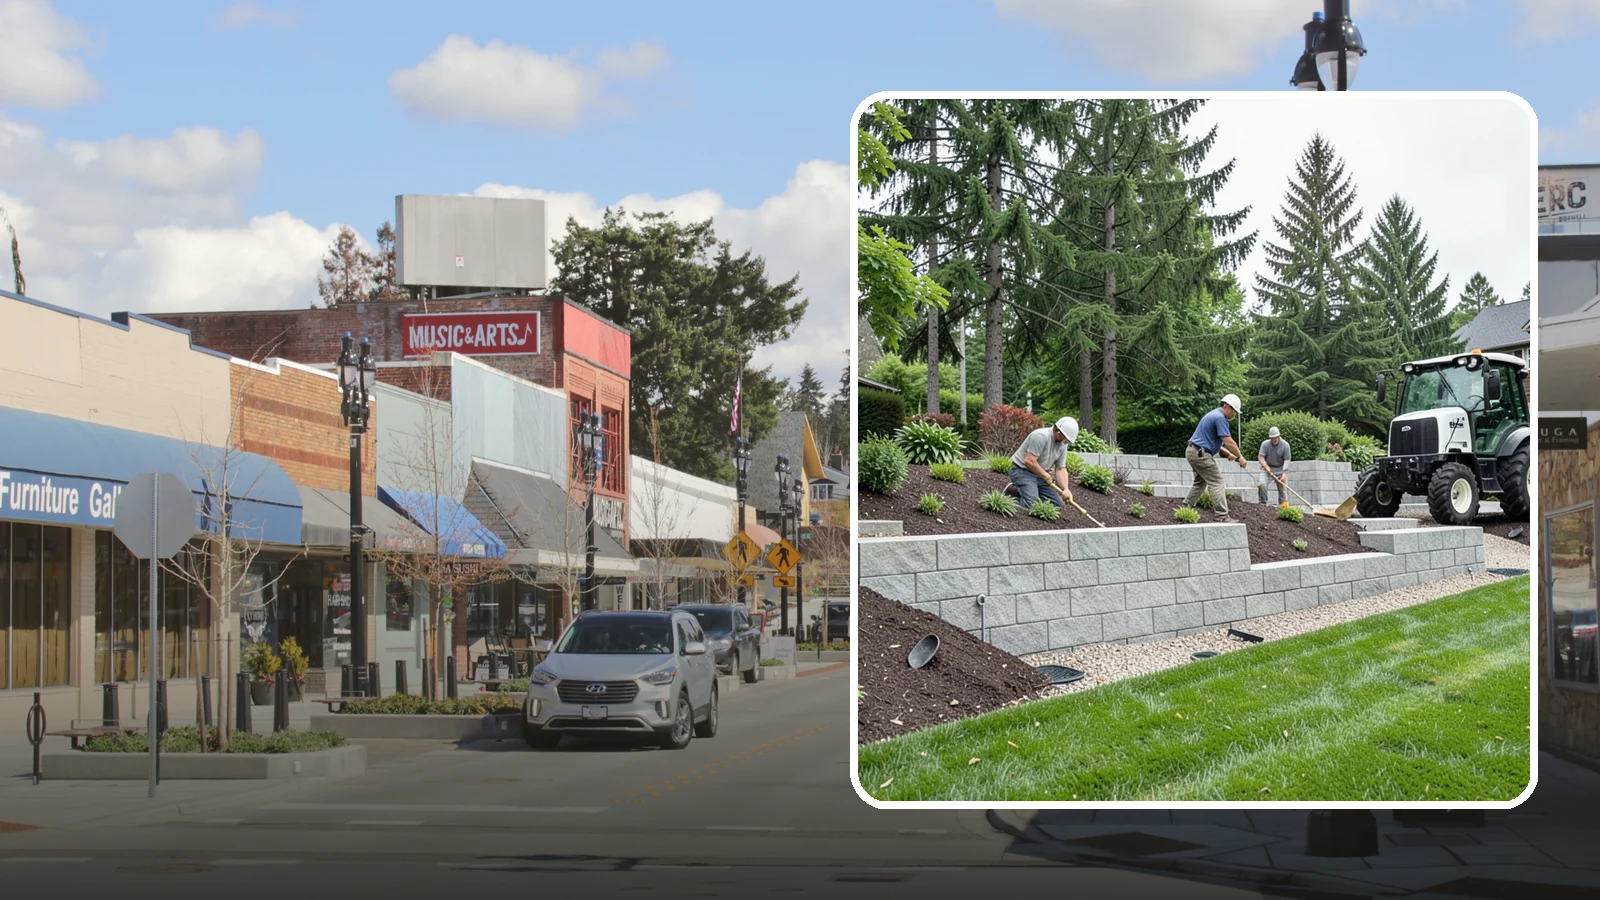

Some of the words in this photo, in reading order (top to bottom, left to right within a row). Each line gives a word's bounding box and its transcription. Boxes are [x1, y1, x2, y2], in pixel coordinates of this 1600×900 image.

[1540, 428, 1577, 436] UGA
[0, 471, 79, 515] Furniture
[89, 483, 121, 519] Gal
[453, 563, 479, 574] SUSHI
